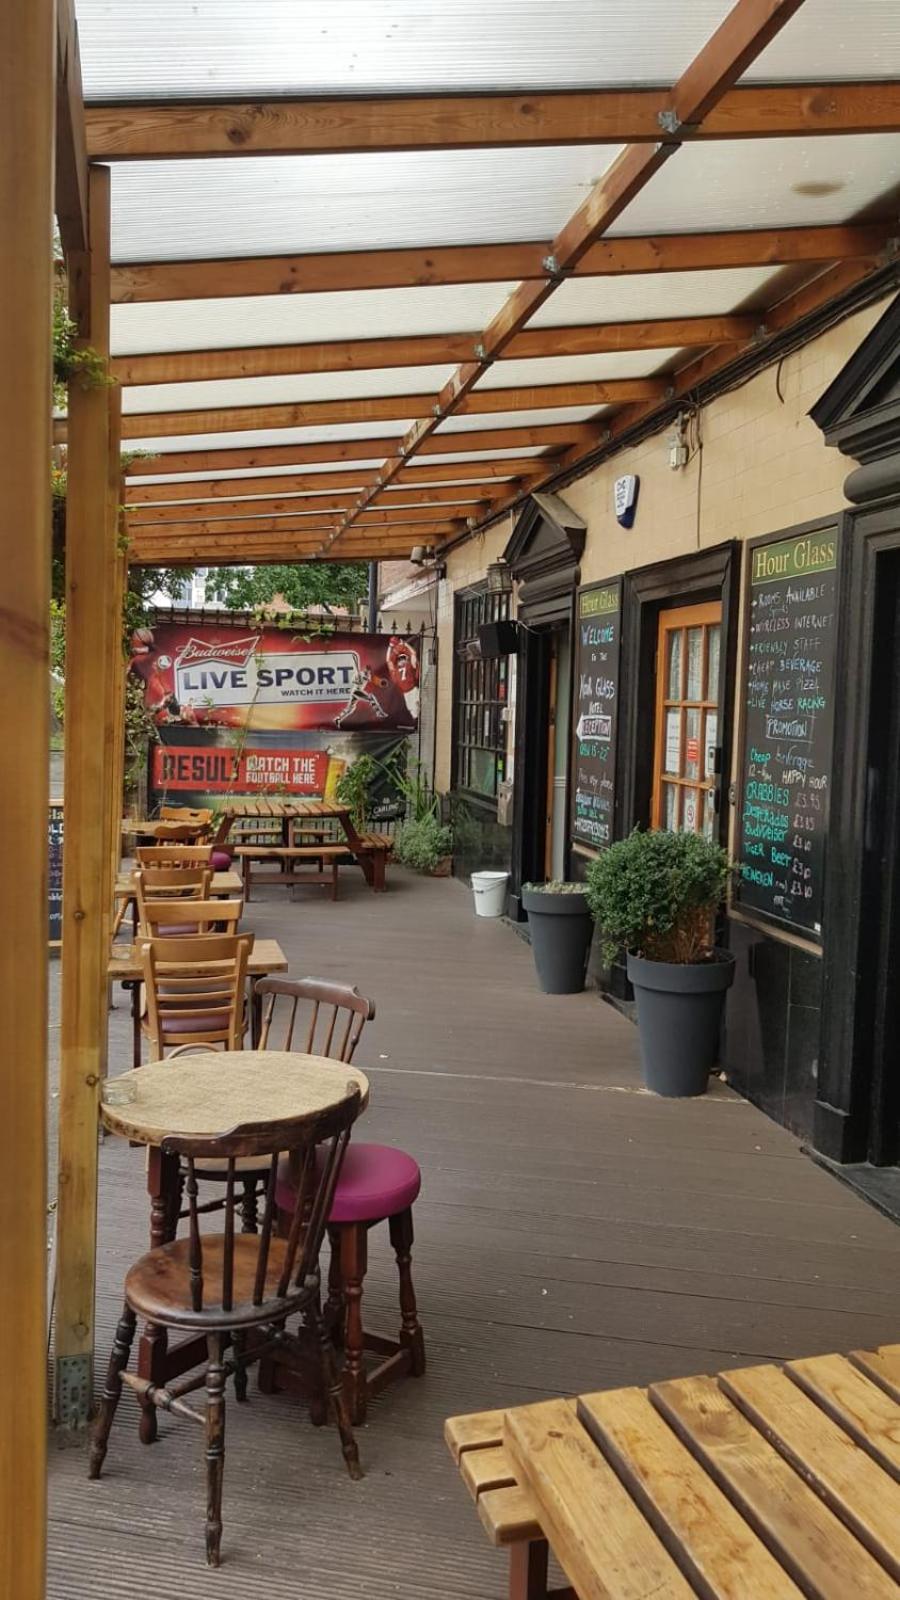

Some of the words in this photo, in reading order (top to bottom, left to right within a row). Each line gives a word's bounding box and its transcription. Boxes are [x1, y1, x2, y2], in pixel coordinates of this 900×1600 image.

[755, 551, 790, 578] Hour
[793, 540, 835, 569] Glass
[175, 644, 256, 659] Budweiser
[793, 636, 821, 652] STAFF
[779, 657, 823, 673] BEVERAGE
[183, 669, 248, 690] LIVE
[256, 666, 354, 688] SPORT
[281, 688, 314, 697] WATCH
[314, 688, 326, 696] IT
[326, 687, 351, 696] HERE
[751, 698, 767, 709] LIVE
[771, 697, 794, 713] HORSE
[797, 696, 826, 711] RACING
[293, 757, 316, 772] THE
[246, 771, 291, 785] FOOTBALL
[292, 772, 316, 785] HERE
[782, 769, 807, 788] HAPPY
[809, 774, 828, 790] HOUR
